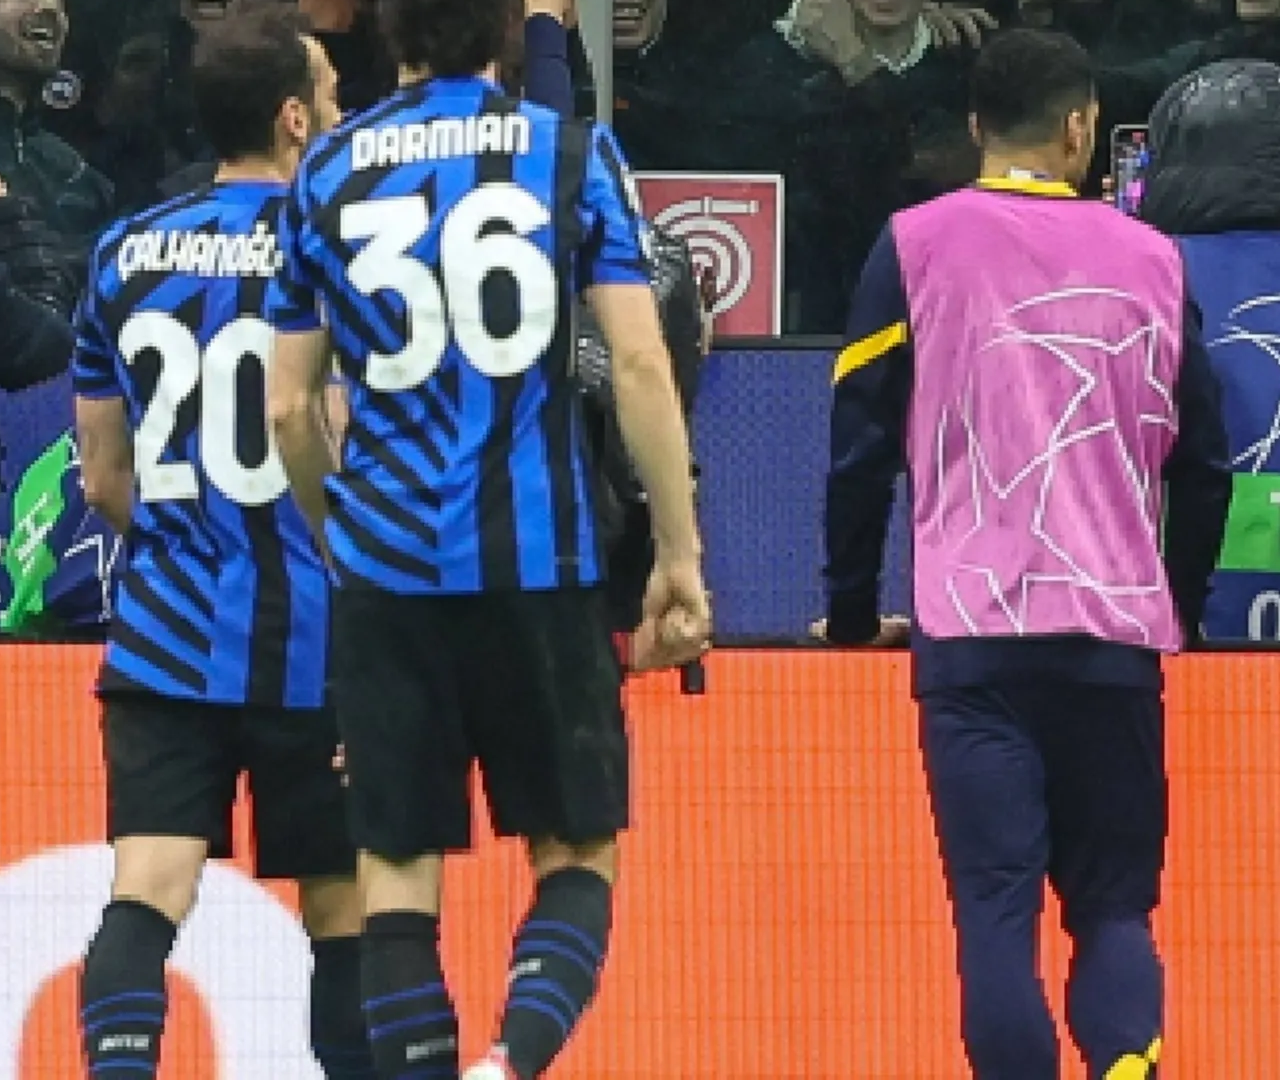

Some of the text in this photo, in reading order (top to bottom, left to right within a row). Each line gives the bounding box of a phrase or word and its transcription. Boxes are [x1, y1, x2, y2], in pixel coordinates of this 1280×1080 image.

[351, 114, 532, 169] DARMIAN
[339, 182, 560, 392] 36
[118, 310, 290, 507] 20
